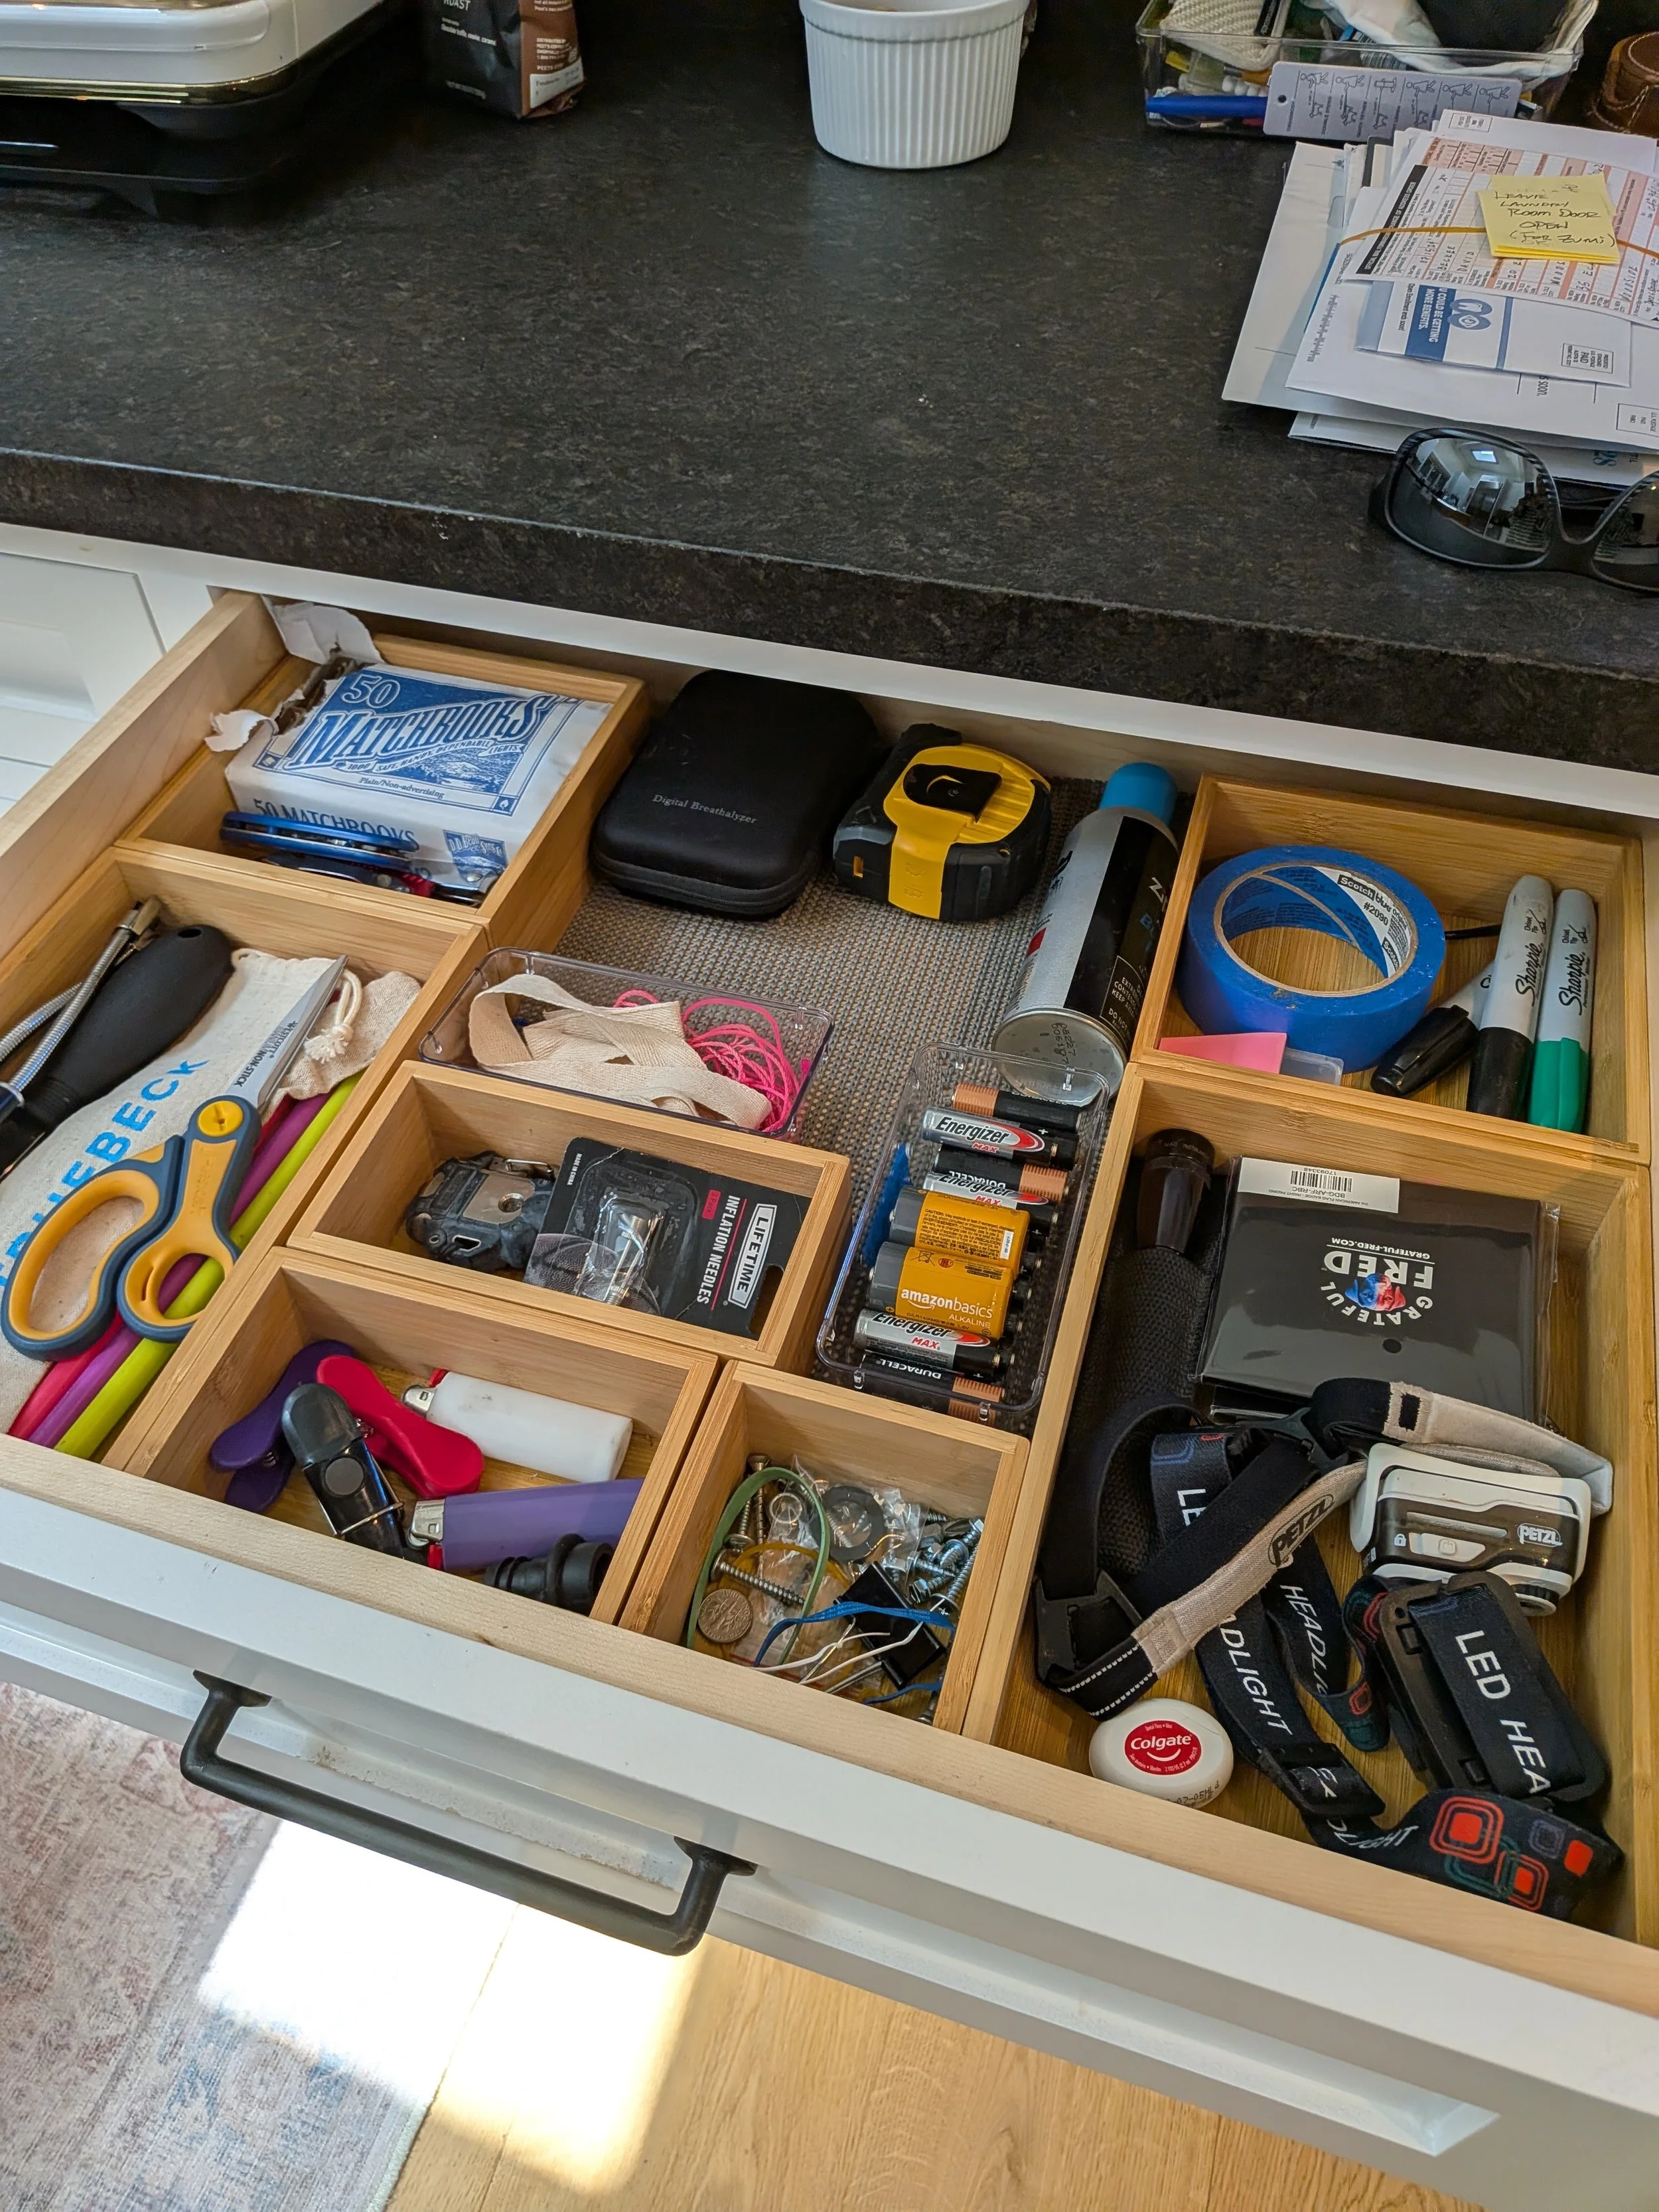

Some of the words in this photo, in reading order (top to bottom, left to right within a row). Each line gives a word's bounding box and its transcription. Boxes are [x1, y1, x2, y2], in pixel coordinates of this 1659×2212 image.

[1402, 293, 1412, 311] Enrollment
[1423, 288, 1435, 304] MORE
[1435, 292, 1447, 310] COULD
[1433, 310, 1443, 319] BE
[1428, 317, 1441, 343] GETTING
[1579, 351, 1589, 364] PAID
[1536, 380, 1548, 396] soon.
[340, 674, 401, 709] 50
[284, 692, 559, 771] MATCHBOOKS
[435, 740, 492, 756] DEPENDABLE
[488, 744, 518, 755] LIGHTS
[359, 776, 446, 800] Plain/Non-advertising
[652, 794, 689, 808] Digital
[690, 801, 757, 824] Breathalyzer
[1340, 877, 1374, 900] Scotch
[1376, 892, 1392, 913] blue
[1363, 901, 1390, 926] #2090
[1524, 917, 1533, 931] Chisel
[1516, 942, 1542, 1007] Sharpie
[1559, 953, 1585, 1016] Sharpie
[1110, 988, 1127, 1003] KEEP
[1106, 1007, 1119, 1019] DO
[1117, 1016, 1127, 1031] NOT
[234, 1049, 267, 1087] NON-STICK
[935, 1116, 1012, 1145] Energizer
[573, 1153, 582, 1165] MADE
[972, 1143, 999, 1153] MAX
[567, 1171, 576, 1185] CHINA
[1303, 1167, 1336, 1175] 17093348
[939, 1174, 1014, 1197] Energizer
[1291, 1185, 1345, 1198] BDG-ARF-RBC
[975, 1195, 1003, 1206] MAX
[713, 1195, 741, 1252] INFLATION
[737, 1217, 769, 1293] LIFETIME
[1331, 1236, 1430, 1259] GRATEFUL-FRED.COM
[696, 1252, 723, 1305] NEEDLES
[1322, 1248, 1433, 1289] FRED
[901, 1289, 993, 1319] amazonbasics
[1316, 1280, 1433, 1332] GRATEFUL
[872, 1313, 954, 1337] Energizer
[948, 1313, 991, 1328] ALKALINE
[912, 1337, 940, 1349] MAX
[882, 1359, 942, 1379] DURACELL
[1272, 1497, 1334, 1568] PETZL
[1519, 1525, 1563, 1546] PETZL
[1455, 1630, 1511, 1699] LED
[1131, 1735, 1192, 1751] Colgate
